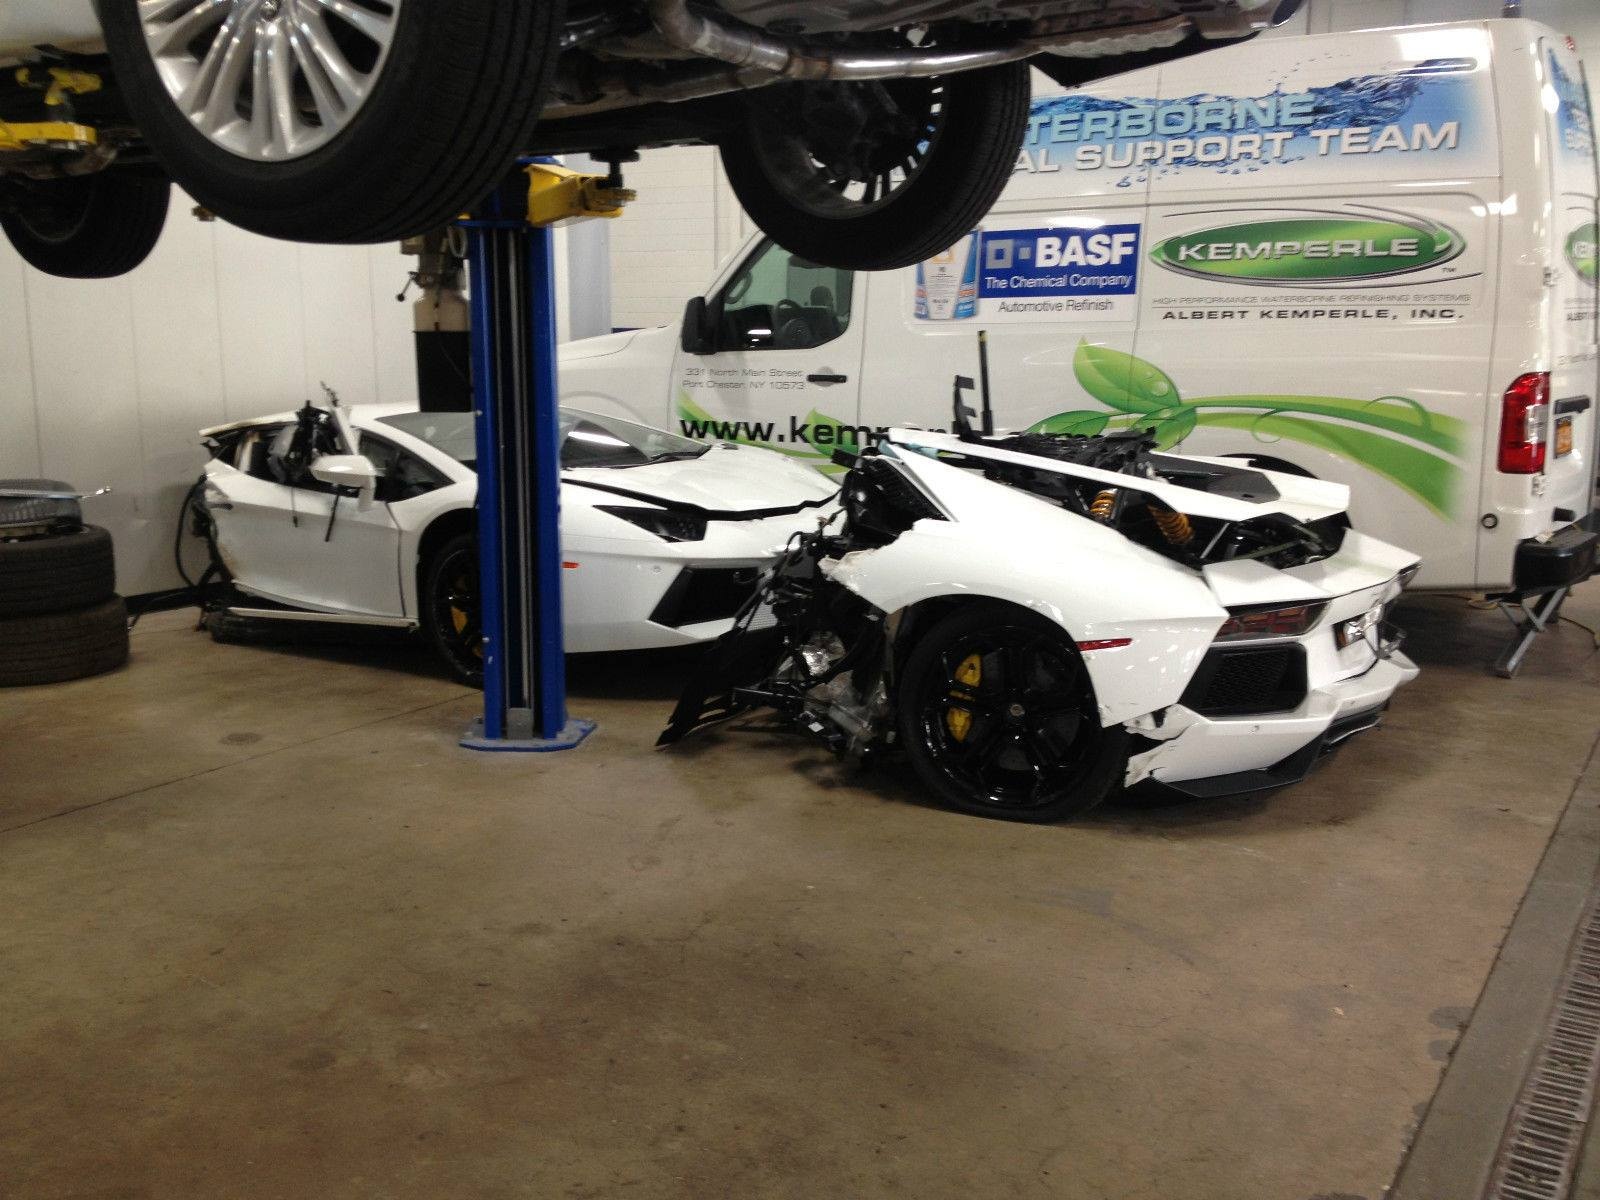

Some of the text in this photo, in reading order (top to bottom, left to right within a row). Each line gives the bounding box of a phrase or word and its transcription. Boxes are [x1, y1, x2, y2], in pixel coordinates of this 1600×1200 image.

[1028, 94, 1317, 144] TERBORNE
[1015, 120, 1462, 173] AL SUPPORT TEAM
[1035, 233, 1136, 267] BASF
[1178, 239, 1418, 261] KEMPERLE
[985, 274, 1134, 289] The Chemical Company
[998, 299, 1114, 312] Automotive Refinish
[1163, 309, 1464, 320] ALBERT KEMPERLE, INC.
